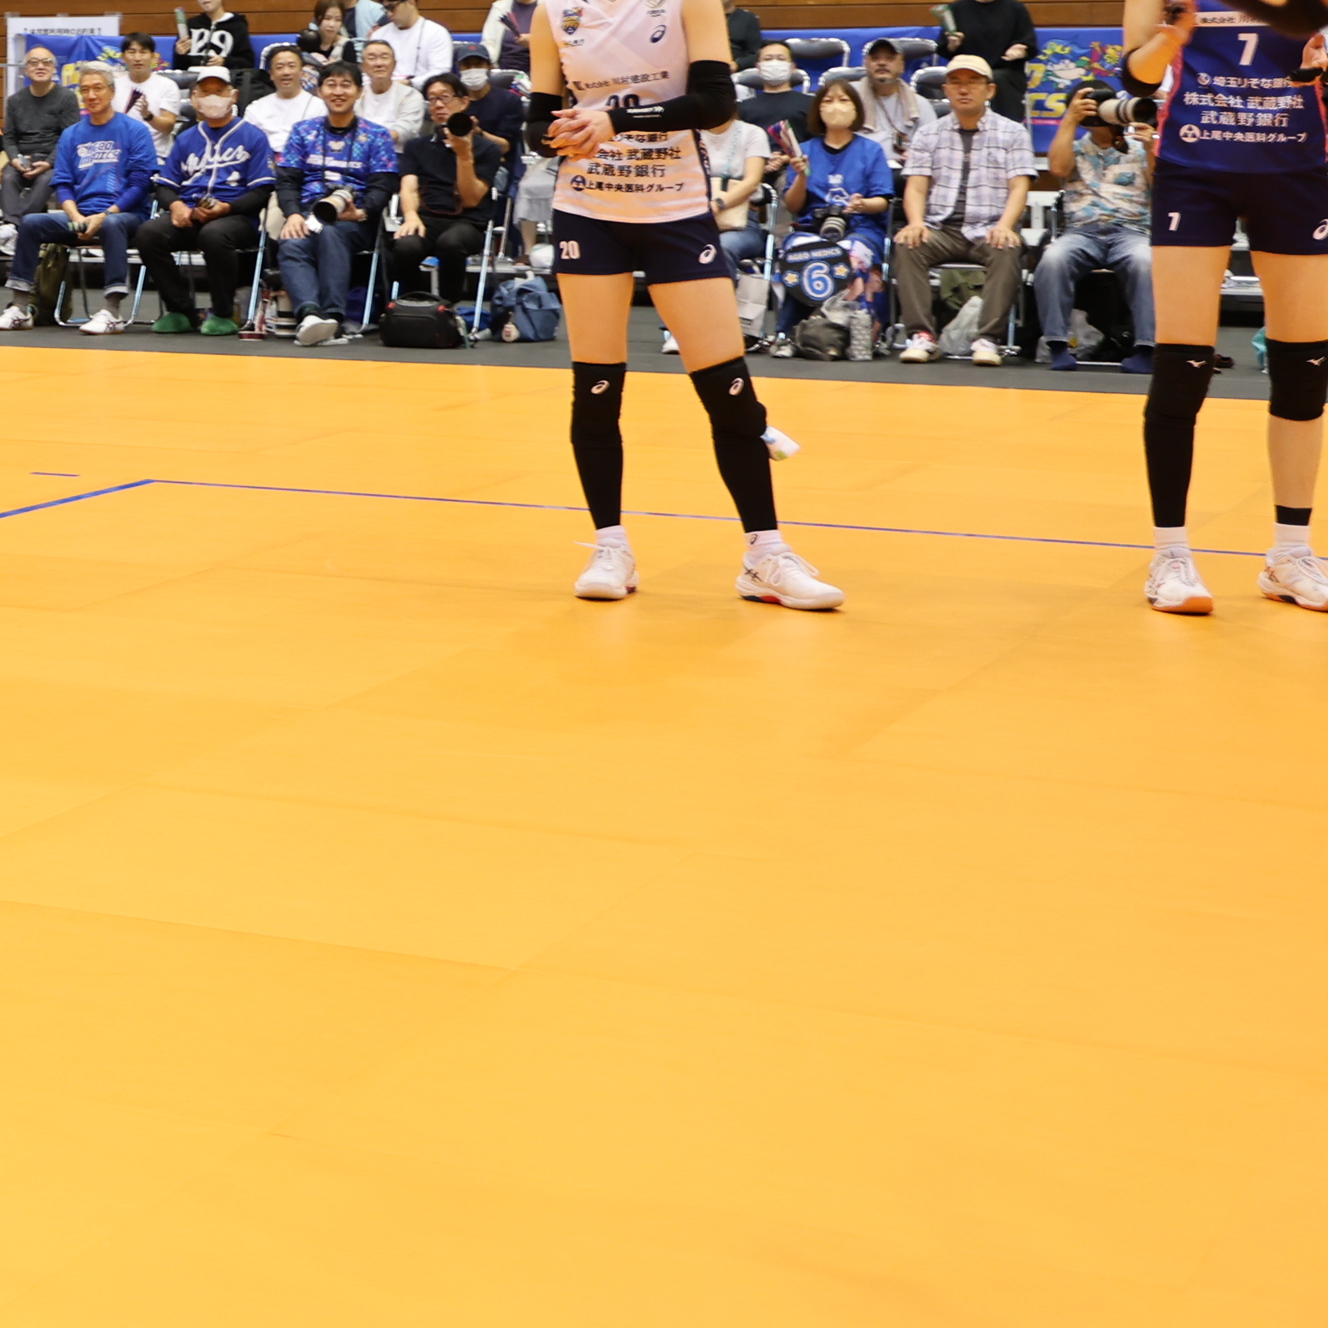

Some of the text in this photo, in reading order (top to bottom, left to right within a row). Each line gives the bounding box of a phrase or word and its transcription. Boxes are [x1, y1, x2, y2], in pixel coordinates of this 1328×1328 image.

[1237, 33, 1259, 66] 7
[1184, 91, 1305, 110] 株式会社 武蔵野社
[1201, 111, 1289, 127] 武蔵野銀行
[1200, 129, 1308, 143] 上尾中央医科グループ
[587, 163, 666, 177] 武蔵野銀行
[586, 181, 685, 193] 上尾中央医科グループ
[559, 240, 581, 260] 20
[803, 261, 834, 299] 6
